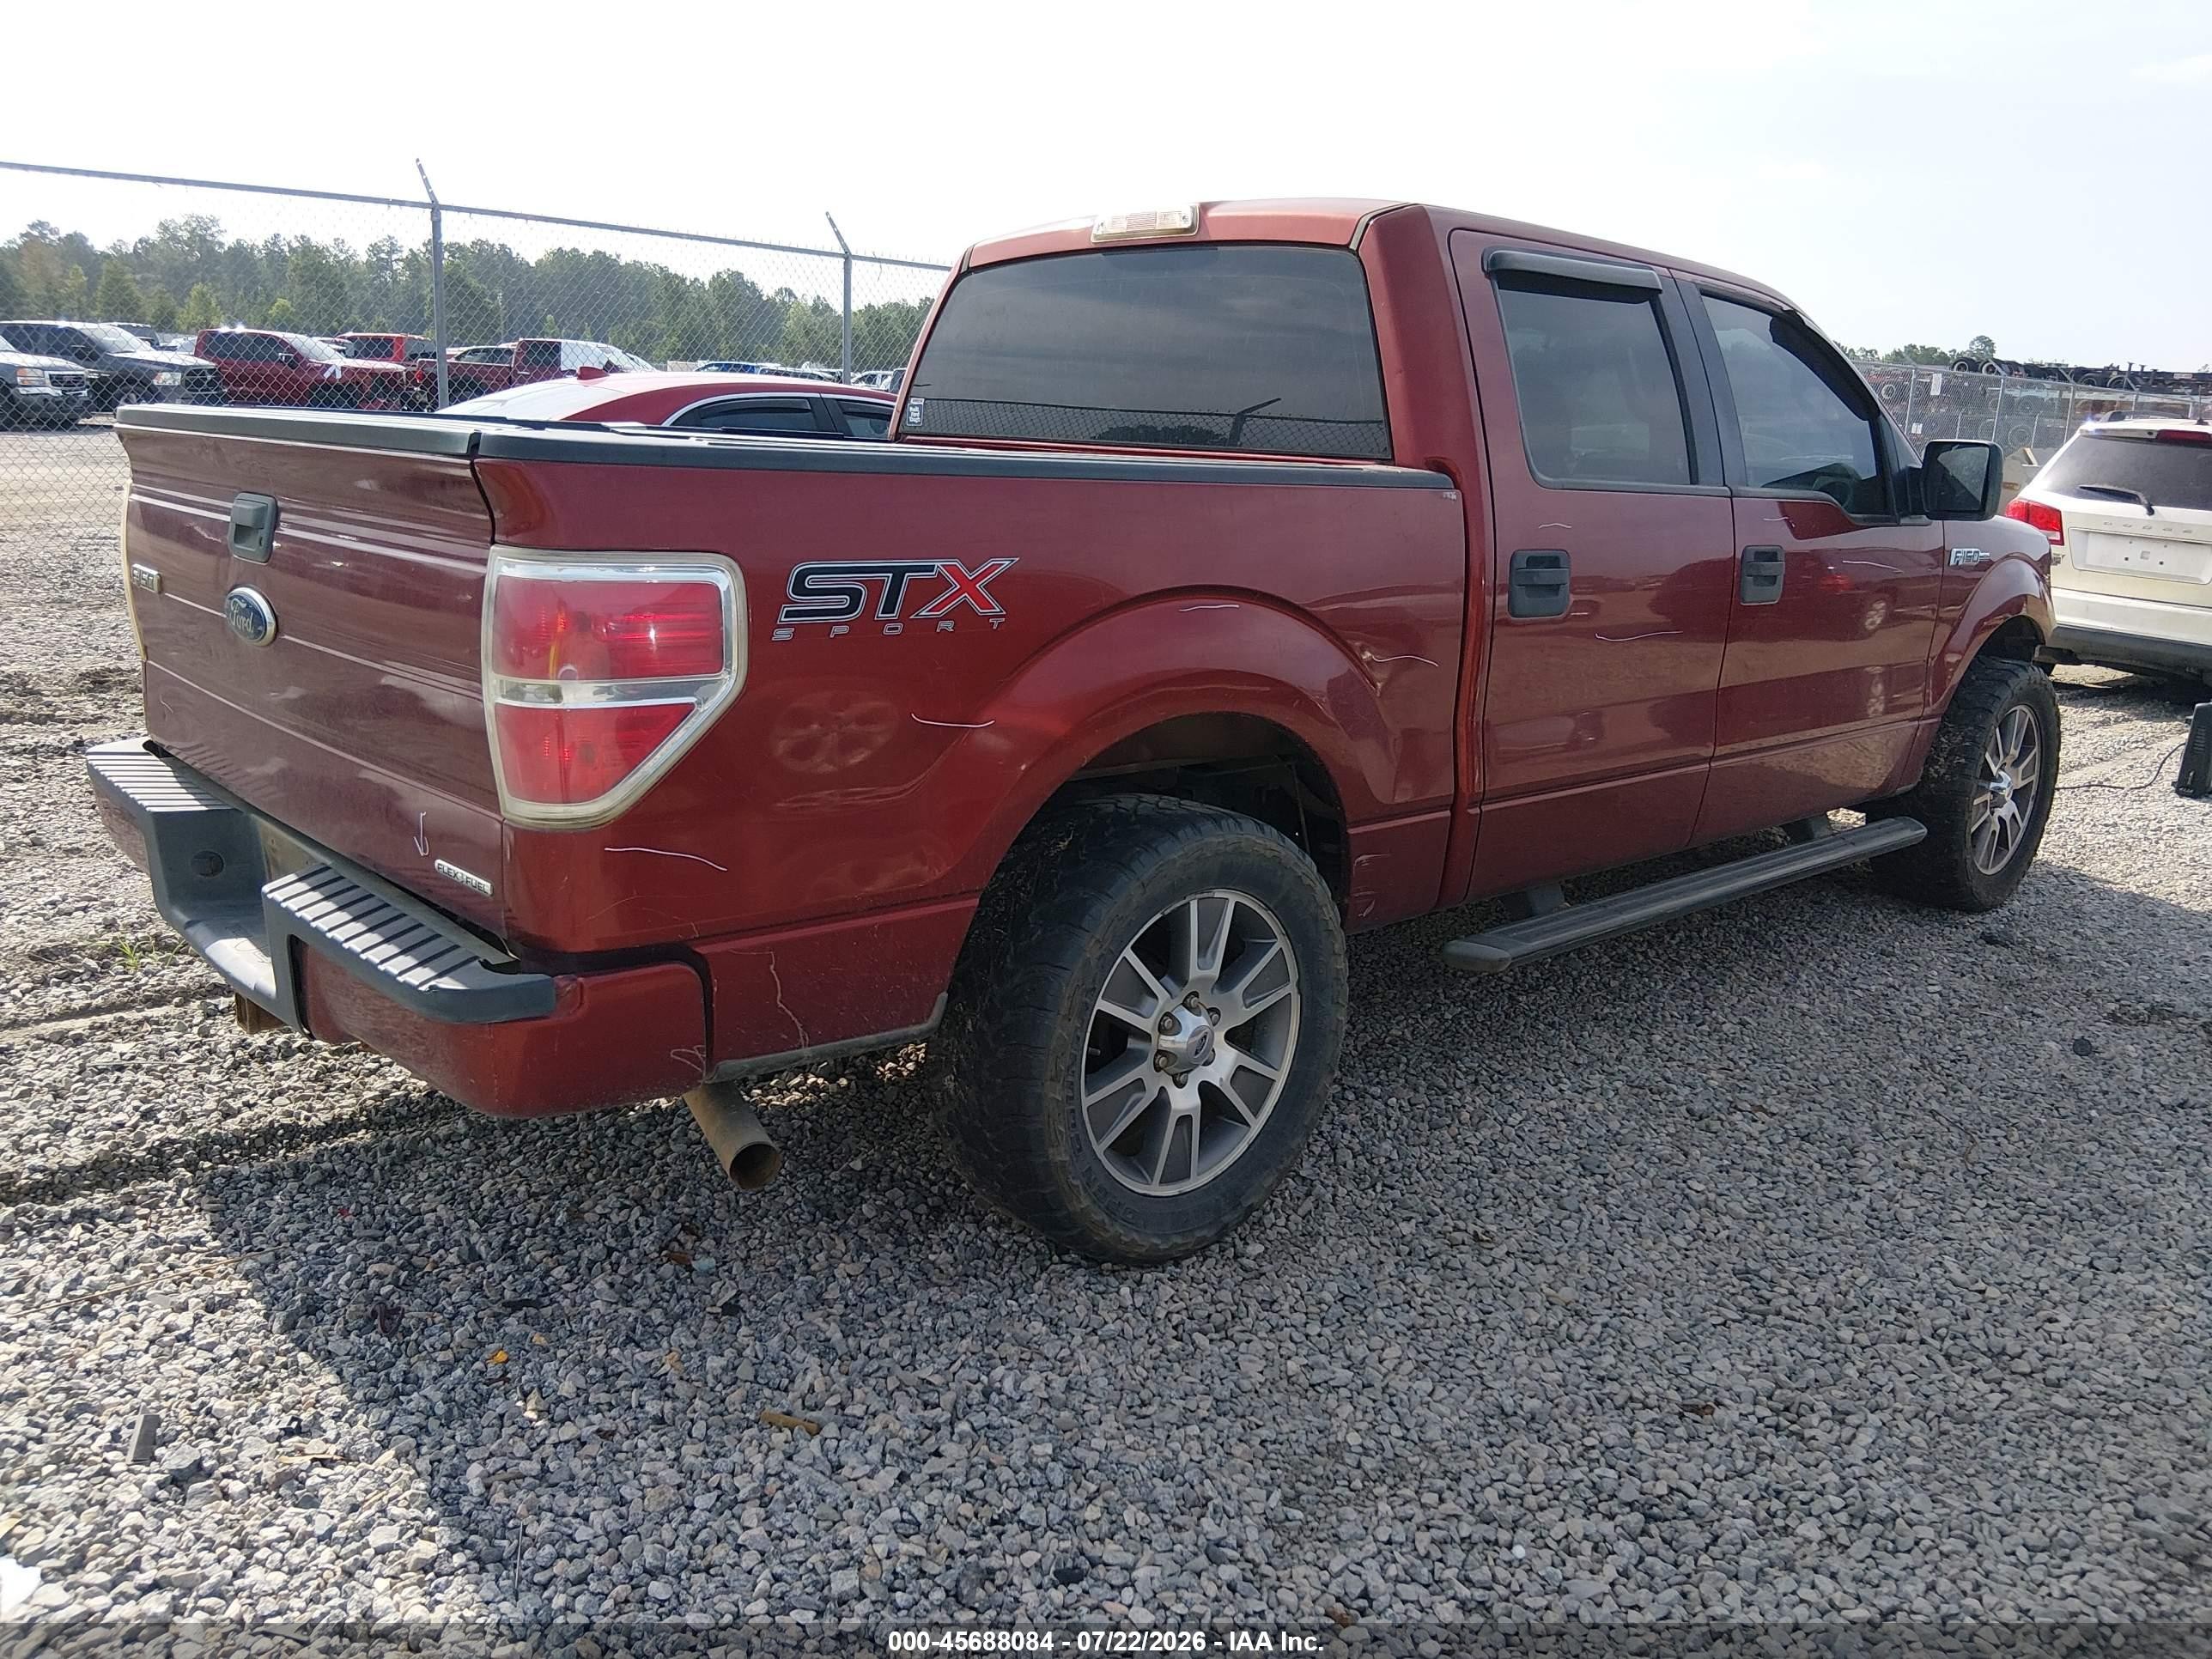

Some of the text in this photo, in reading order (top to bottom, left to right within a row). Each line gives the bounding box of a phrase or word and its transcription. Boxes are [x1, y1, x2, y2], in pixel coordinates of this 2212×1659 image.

[777, 556, 1020, 624] STX
[229, 597, 255, 633] Ford
[771, 617, 1006, 641] SPORT
[436, 862, 489, 894] FLEX FUEL
